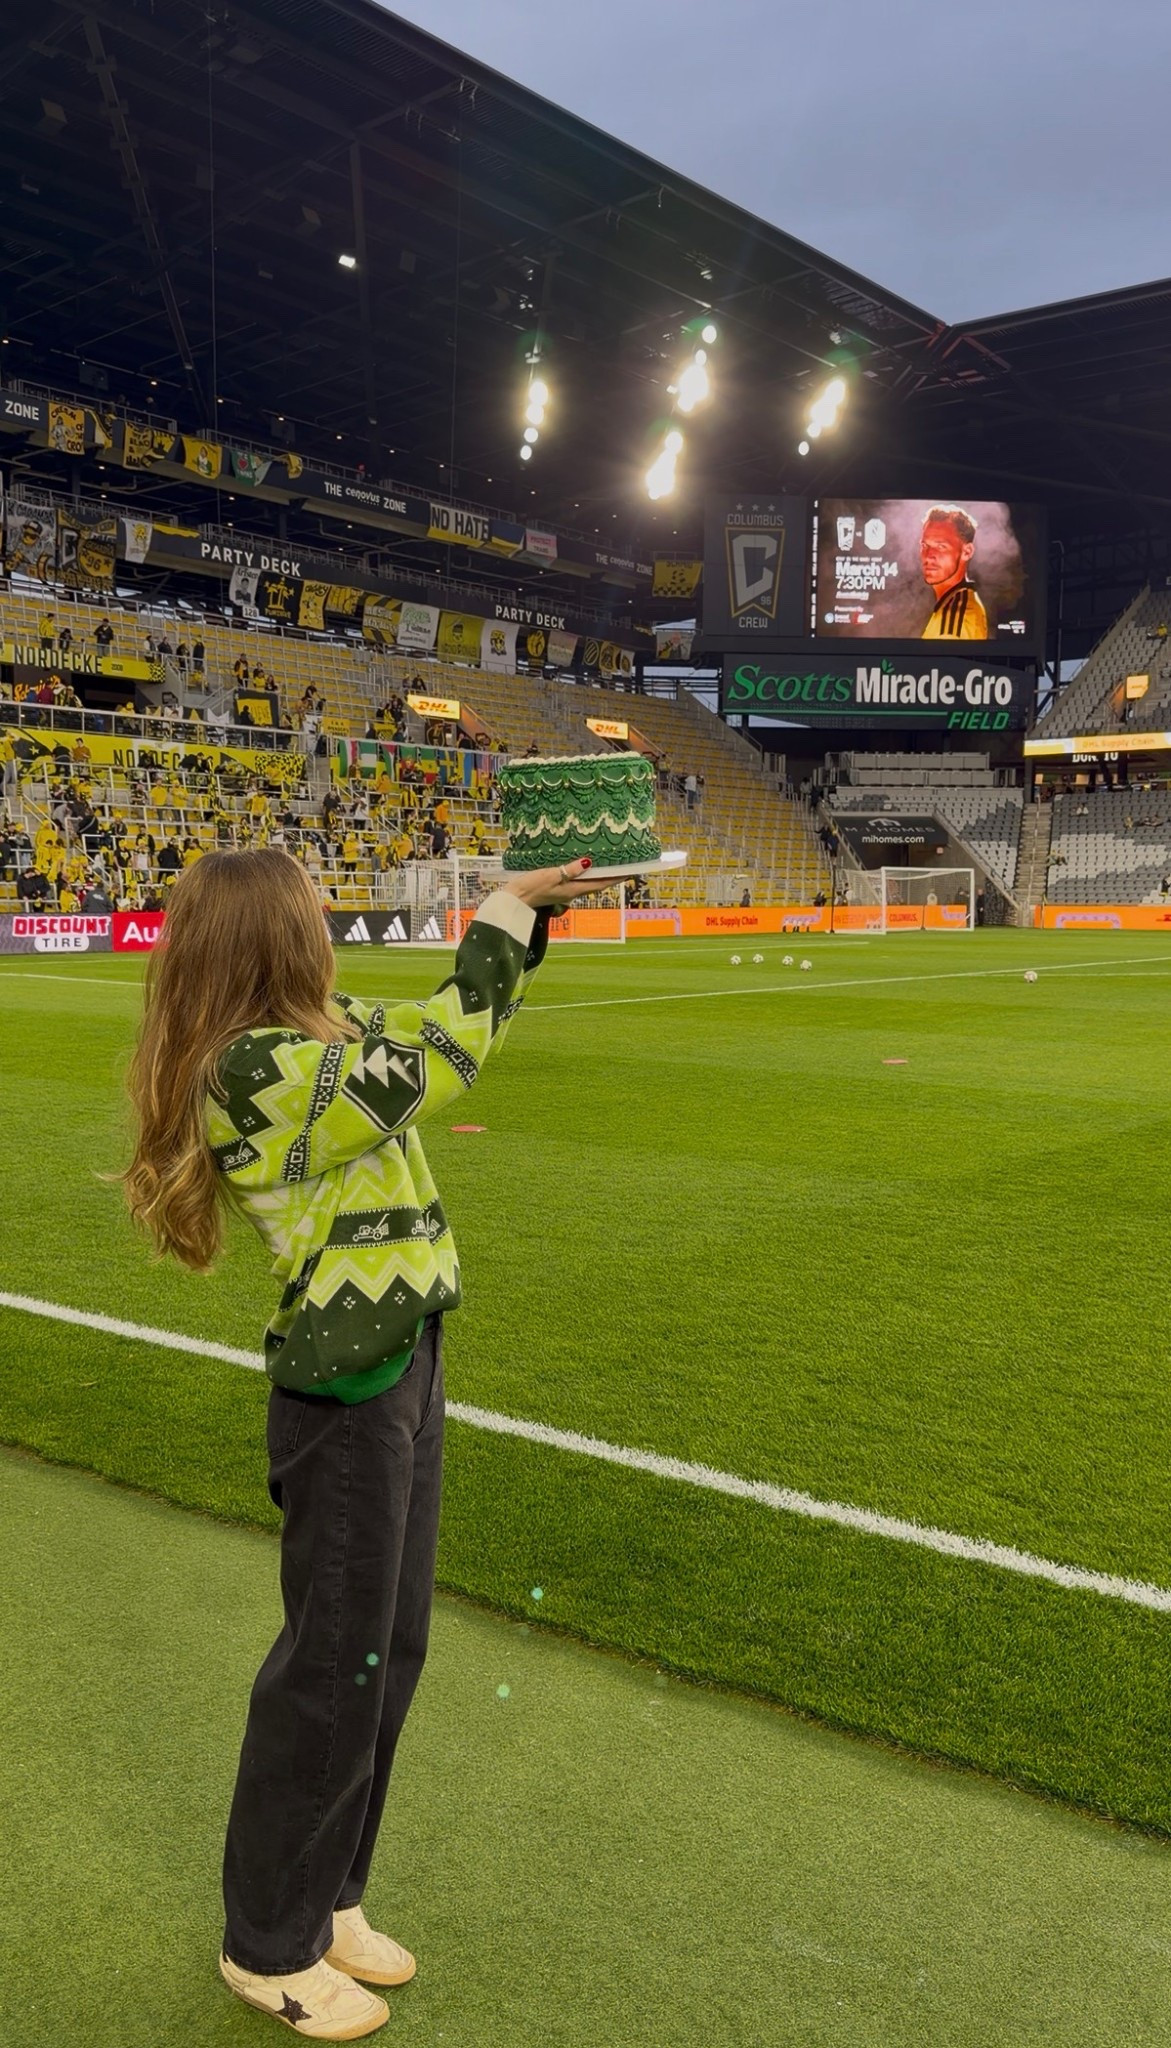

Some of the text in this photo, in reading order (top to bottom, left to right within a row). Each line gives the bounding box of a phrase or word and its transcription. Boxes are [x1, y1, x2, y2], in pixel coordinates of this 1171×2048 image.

[5, 400, 39, 421] ZONE
[324, 482, 342, 497] THE
[345, 487, 380, 503] cenovus
[383, 497, 407, 514] ZONE
[430, 507, 489, 541] NO HATE
[727, 514, 784, 526] COLUMBUS
[201, 543, 301, 577] PARTY DECK
[835, 562, 898, 577] March 14
[835, 576, 886, 590] 7:30PM
[495, 604, 565, 630] PARTY DECK
[738, 617, 768, 628] CREW
[14, 644, 102, 674] NORDECKE
[728, 665, 854, 701] Scotts
[855, 667, 1013, 706] Miracle-Gro
[418, 700, 450, 713] DHL
[595, 723, 623, 735] DHL
[946, 711, 1010, 730] FIELD
[862, 835, 925, 844] mihomes.com
[13, 917, 111, 936] DISCOUNT
[720, 915, 741, 928] Supply
[741, 915, 759, 926] Chain
[122, 922, 160, 943] Au
[42, 937, 82, 948] TIRE
